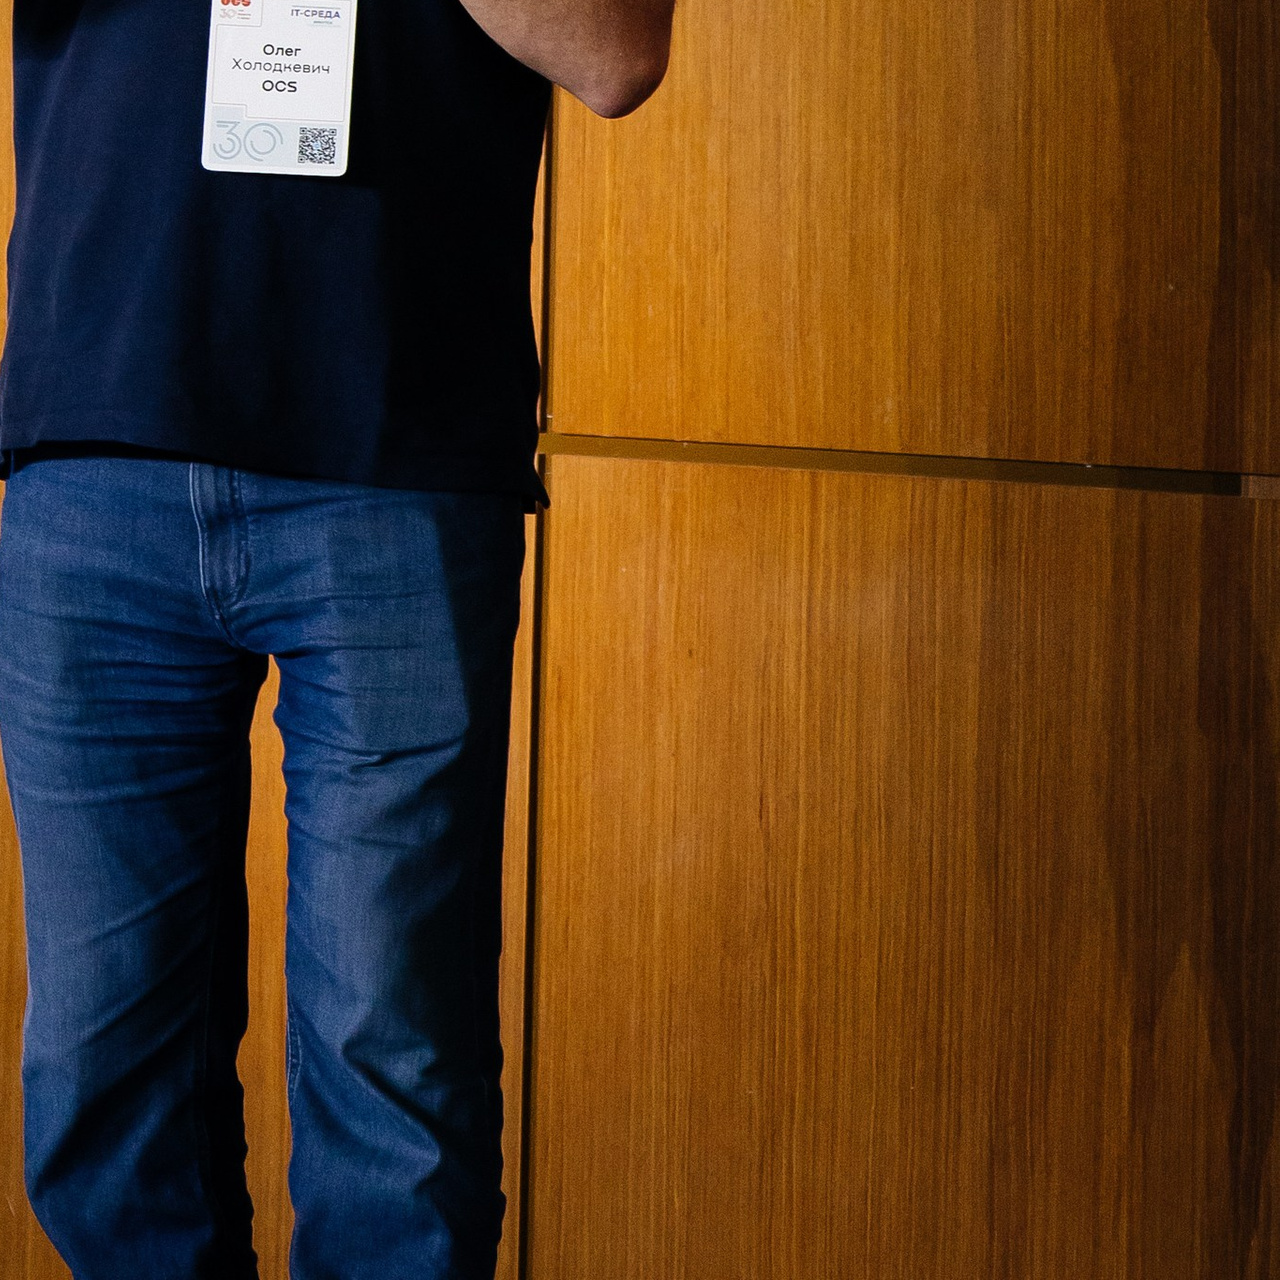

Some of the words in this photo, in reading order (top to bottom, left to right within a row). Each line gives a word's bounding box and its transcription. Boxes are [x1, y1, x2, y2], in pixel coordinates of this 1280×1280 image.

[263, 44, 301, 56] Олег
[232, 57, 331, 75] Холодкевич
[262, 80, 297, 92] OCS
